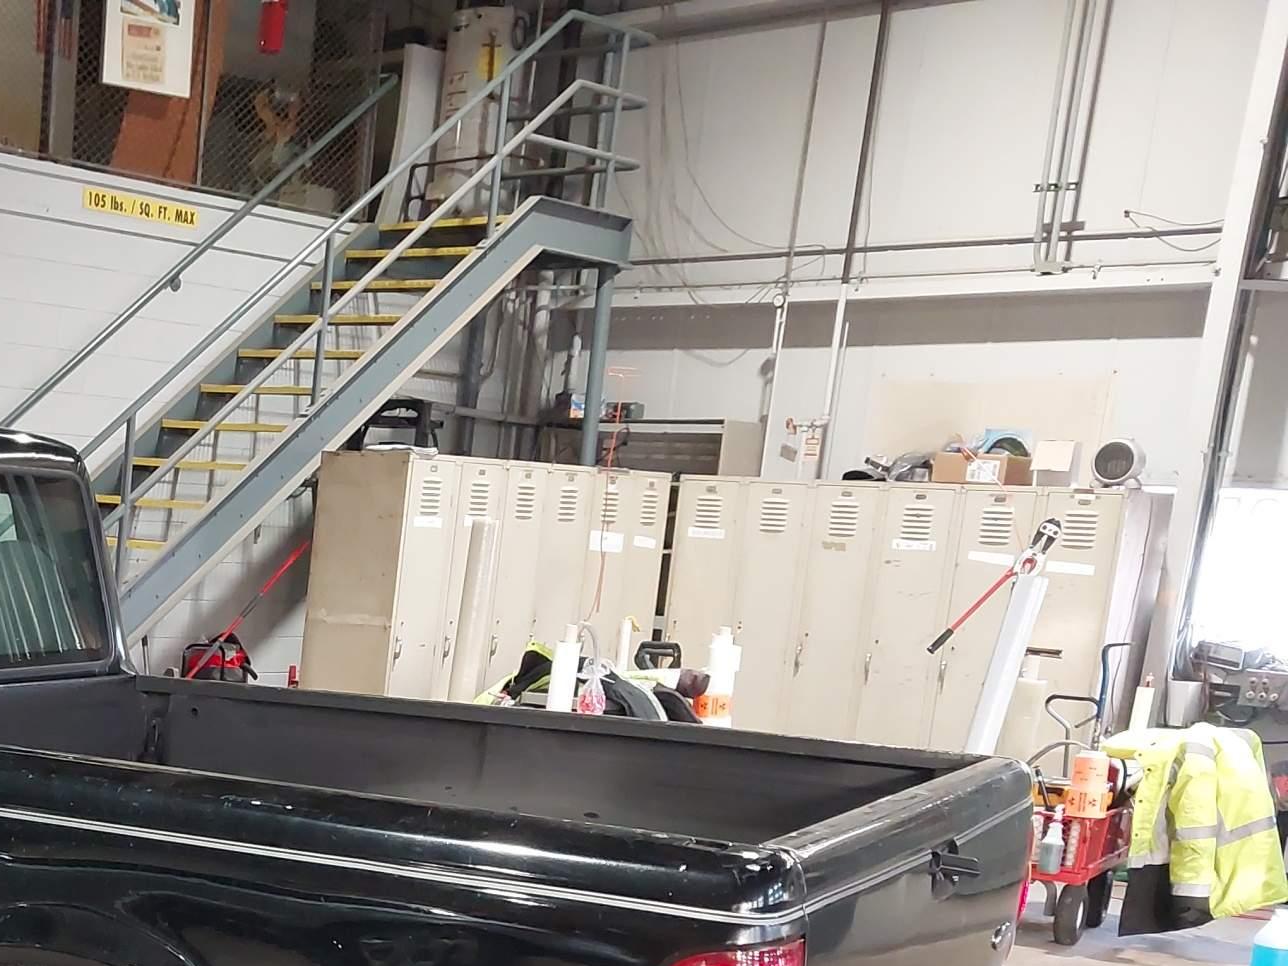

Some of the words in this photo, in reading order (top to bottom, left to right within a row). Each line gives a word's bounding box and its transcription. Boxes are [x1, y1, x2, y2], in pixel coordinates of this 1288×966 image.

[88, 191, 107, 209] 105
[110, 195, 127, 213] lbs.
[131, 200, 136, 216] /
[139, 202, 154, 218] SQ.
[158, 205, 171, 221] FT.
[174, 208, 196, 225] MAX
